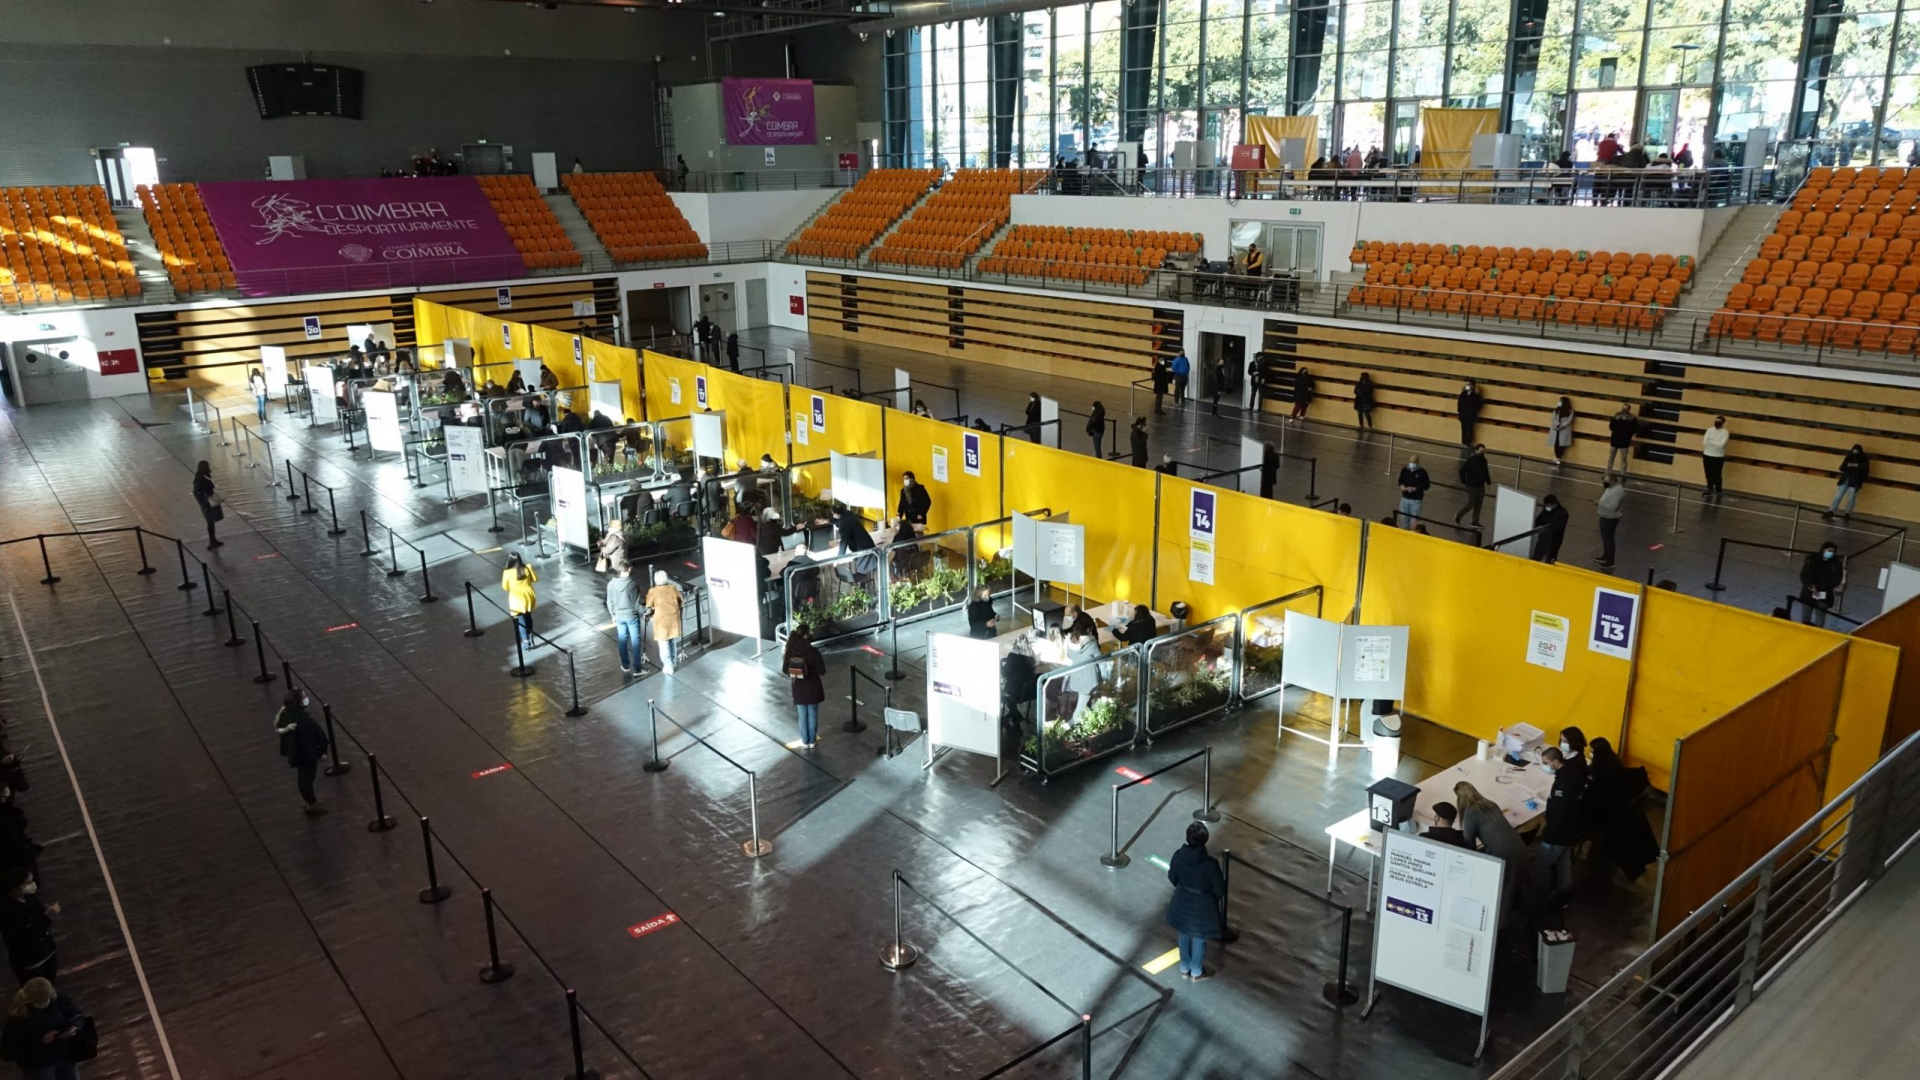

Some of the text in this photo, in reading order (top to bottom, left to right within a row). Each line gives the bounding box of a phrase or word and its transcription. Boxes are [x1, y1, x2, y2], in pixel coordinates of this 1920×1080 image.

[766, 121, 798, 130] COIMBRA
[315, 201, 449, 221] COIMBRA
[326, 219, 479, 236] DESPORTIVAMENTE
[382, 245, 469, 260] COIMBRA
[307, 327, 319, 335] 20
[814, 412, 823, 424] 16
[966, 452, 977, 466] 15
[1195, 512, 1211, 529] 14
[1601, 613, 1620, 623] MESA
[1600, 620, 1625, 641] 13
[1538, 641, 1557, 652] 2021
[1373, 806, 1391, 823] 13
[1390, 856, 1407, 864] LOPES
[1391, 851, 1413, 861] MANUEL
[1414, 858, 1432, 866] MARIA
[1389, 869, 1406, 878] MARIA
[1390, 860, 1411, 870] SANTOS
[1411, 866, 1437, 877] QUELHAS
[1415, 911, 1429, 923] 13
[634, 918, 666, 934] SAÍDA
